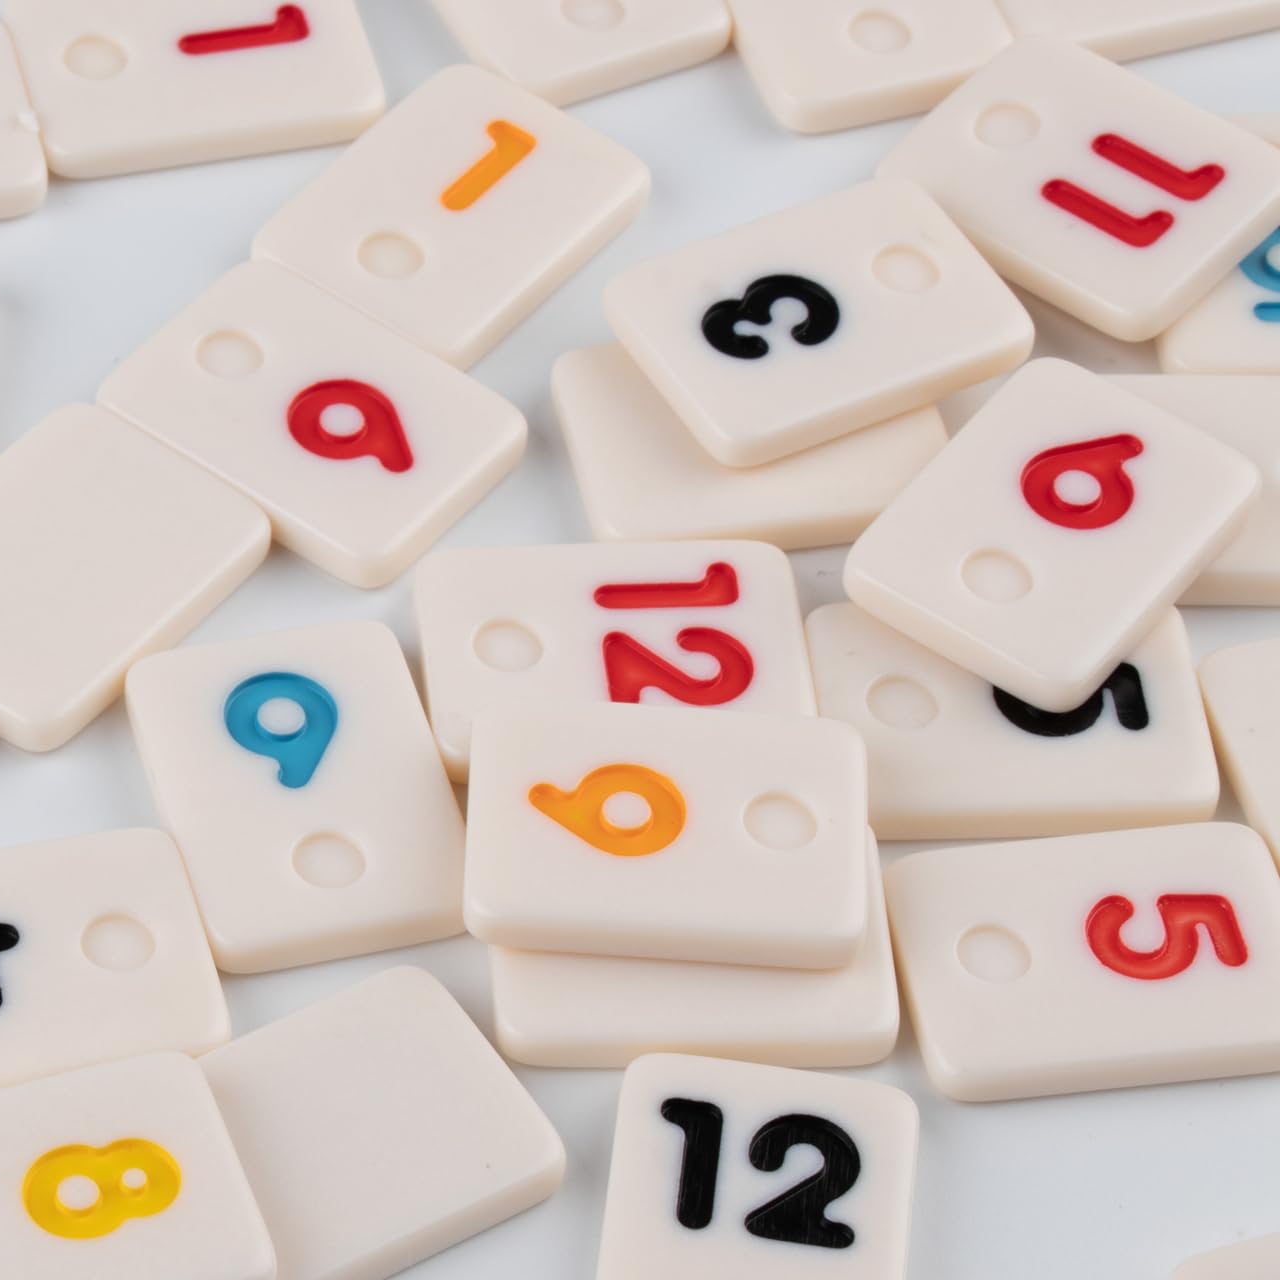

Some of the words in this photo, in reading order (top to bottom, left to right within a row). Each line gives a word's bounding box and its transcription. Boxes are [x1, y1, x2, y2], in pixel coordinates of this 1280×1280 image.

[178, 4, 309, 55] 1
[440, 120, 537, 211] 1
[1041, 134, 1225, 248] 11
[702, 275, 839, 359] 3
[593, 562, 754, 706] 12
[1085, 894, 1248, 980] 5
[21, 1138, 182, 1240] 8
[661, 1098, 861, 1249] 12
